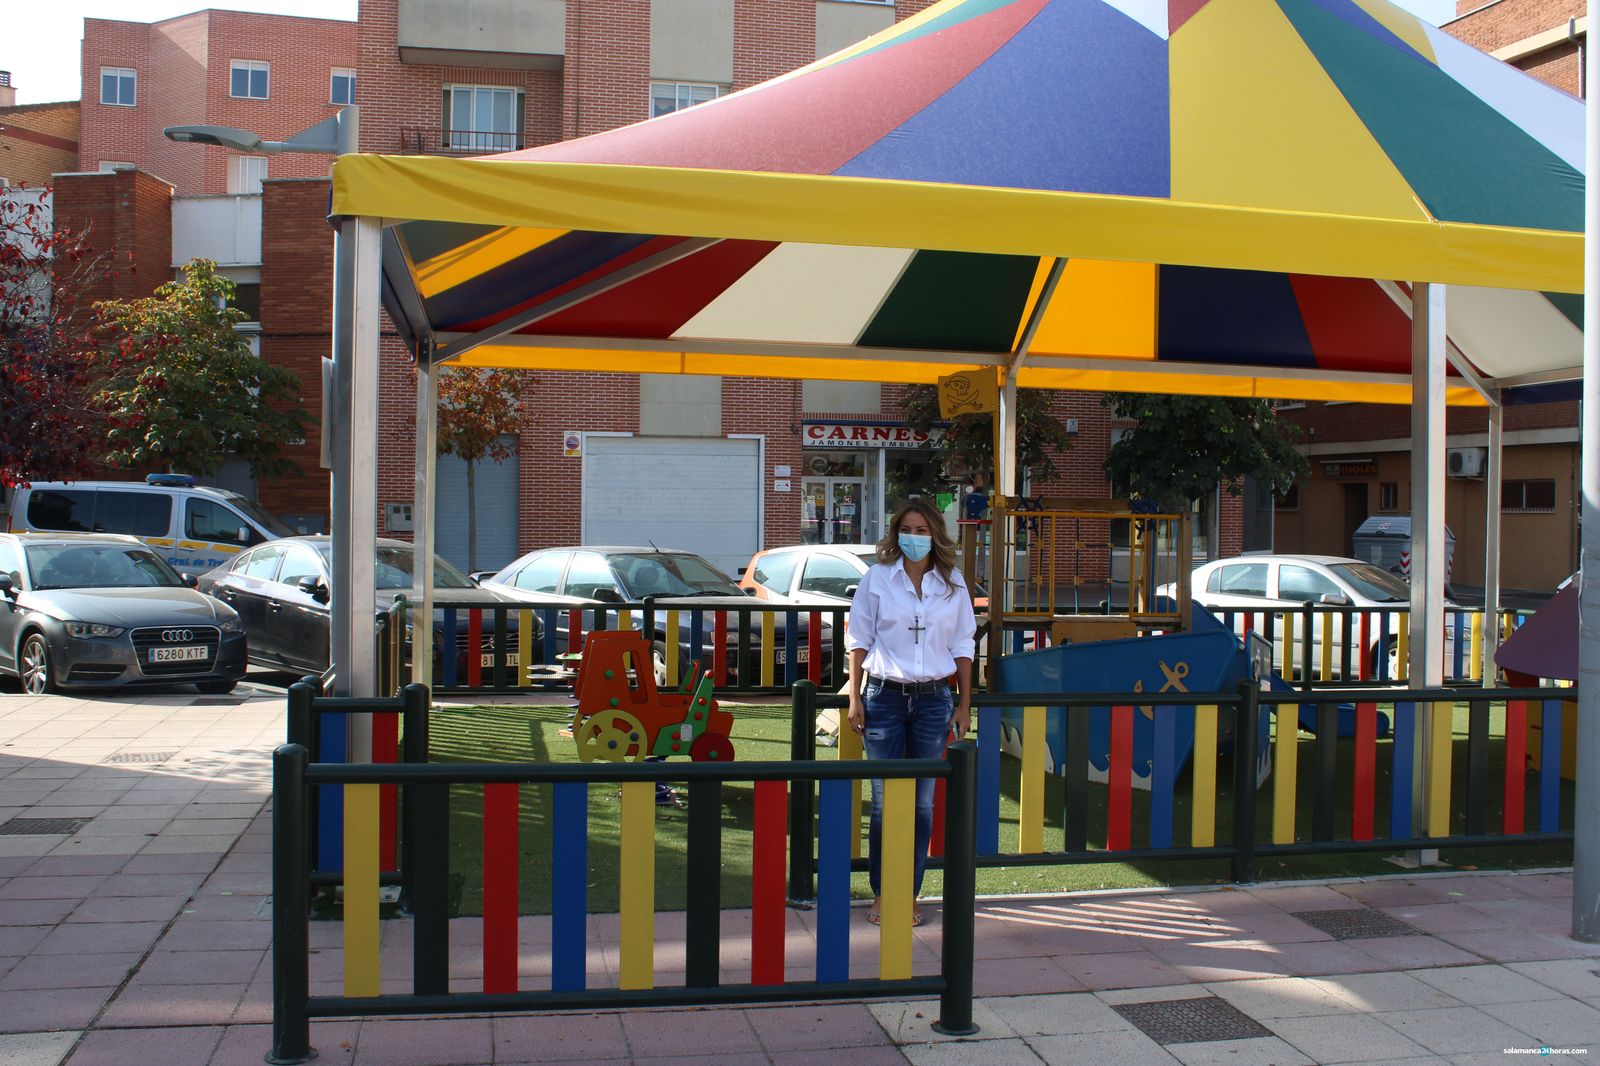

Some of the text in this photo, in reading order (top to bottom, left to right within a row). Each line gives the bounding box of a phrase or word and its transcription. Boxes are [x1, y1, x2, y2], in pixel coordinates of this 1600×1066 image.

[807, 425, 929, 442] CARNES
[157, 647, 205, 660] 6280 KTF
